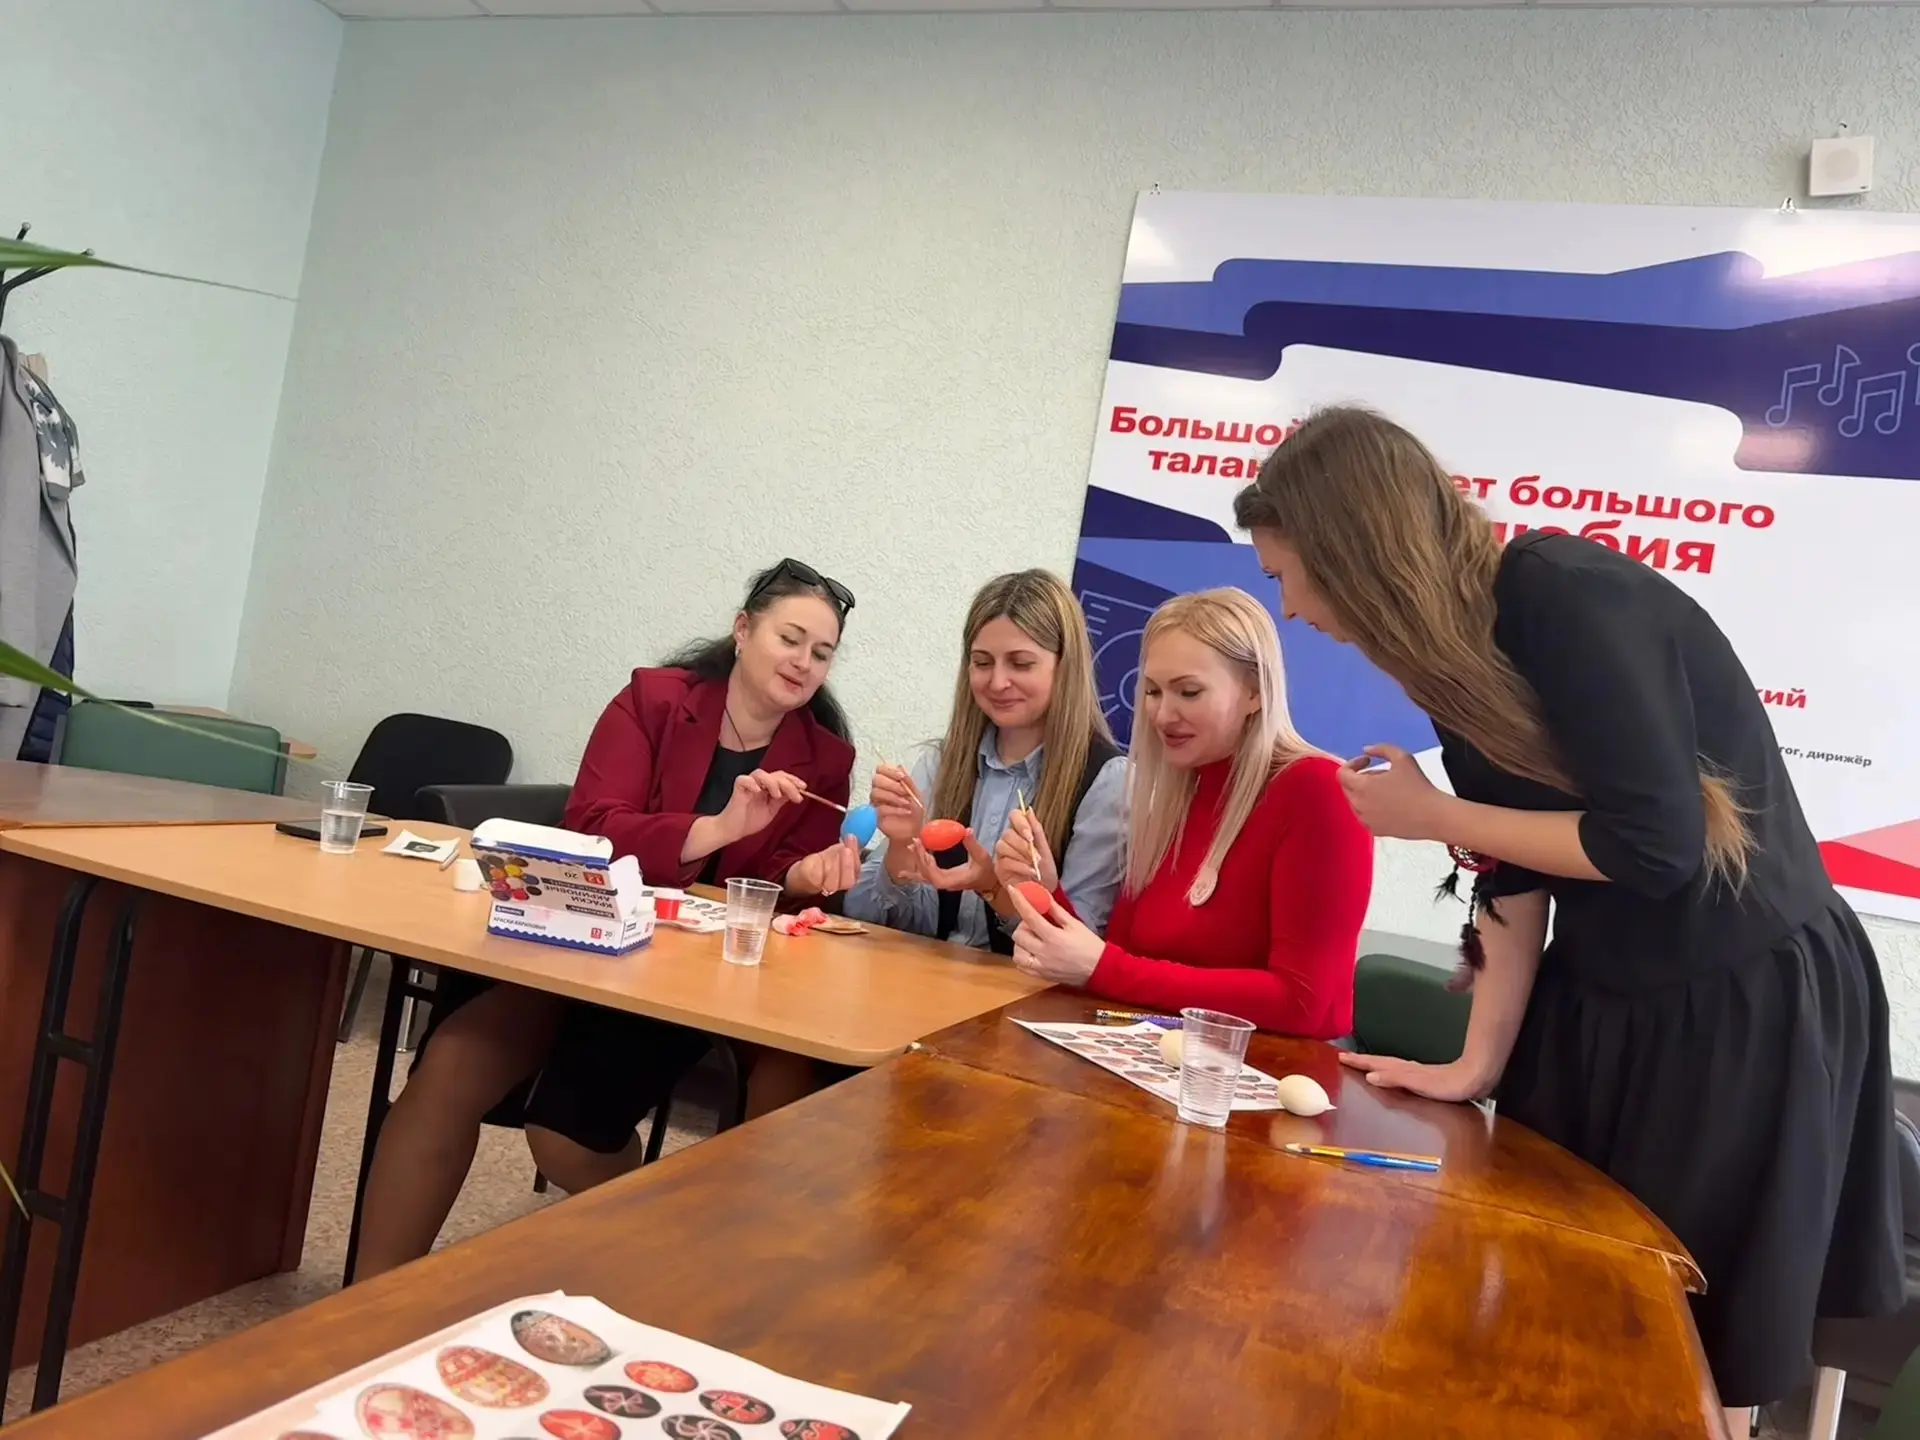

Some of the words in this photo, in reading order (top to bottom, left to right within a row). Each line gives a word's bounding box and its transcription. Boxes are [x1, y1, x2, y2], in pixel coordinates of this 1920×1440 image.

[1449, 474, 1498, 500] ет
[1509, 475, 1775, 529] большого
[1756, 687, 1806, 709] ий
[1806, 750, 1872, 768] дирижёр
[544, 885, 611, 902] АКРИЛОВЫЕ
[571, 896, 613, 909] КРАСКИ
